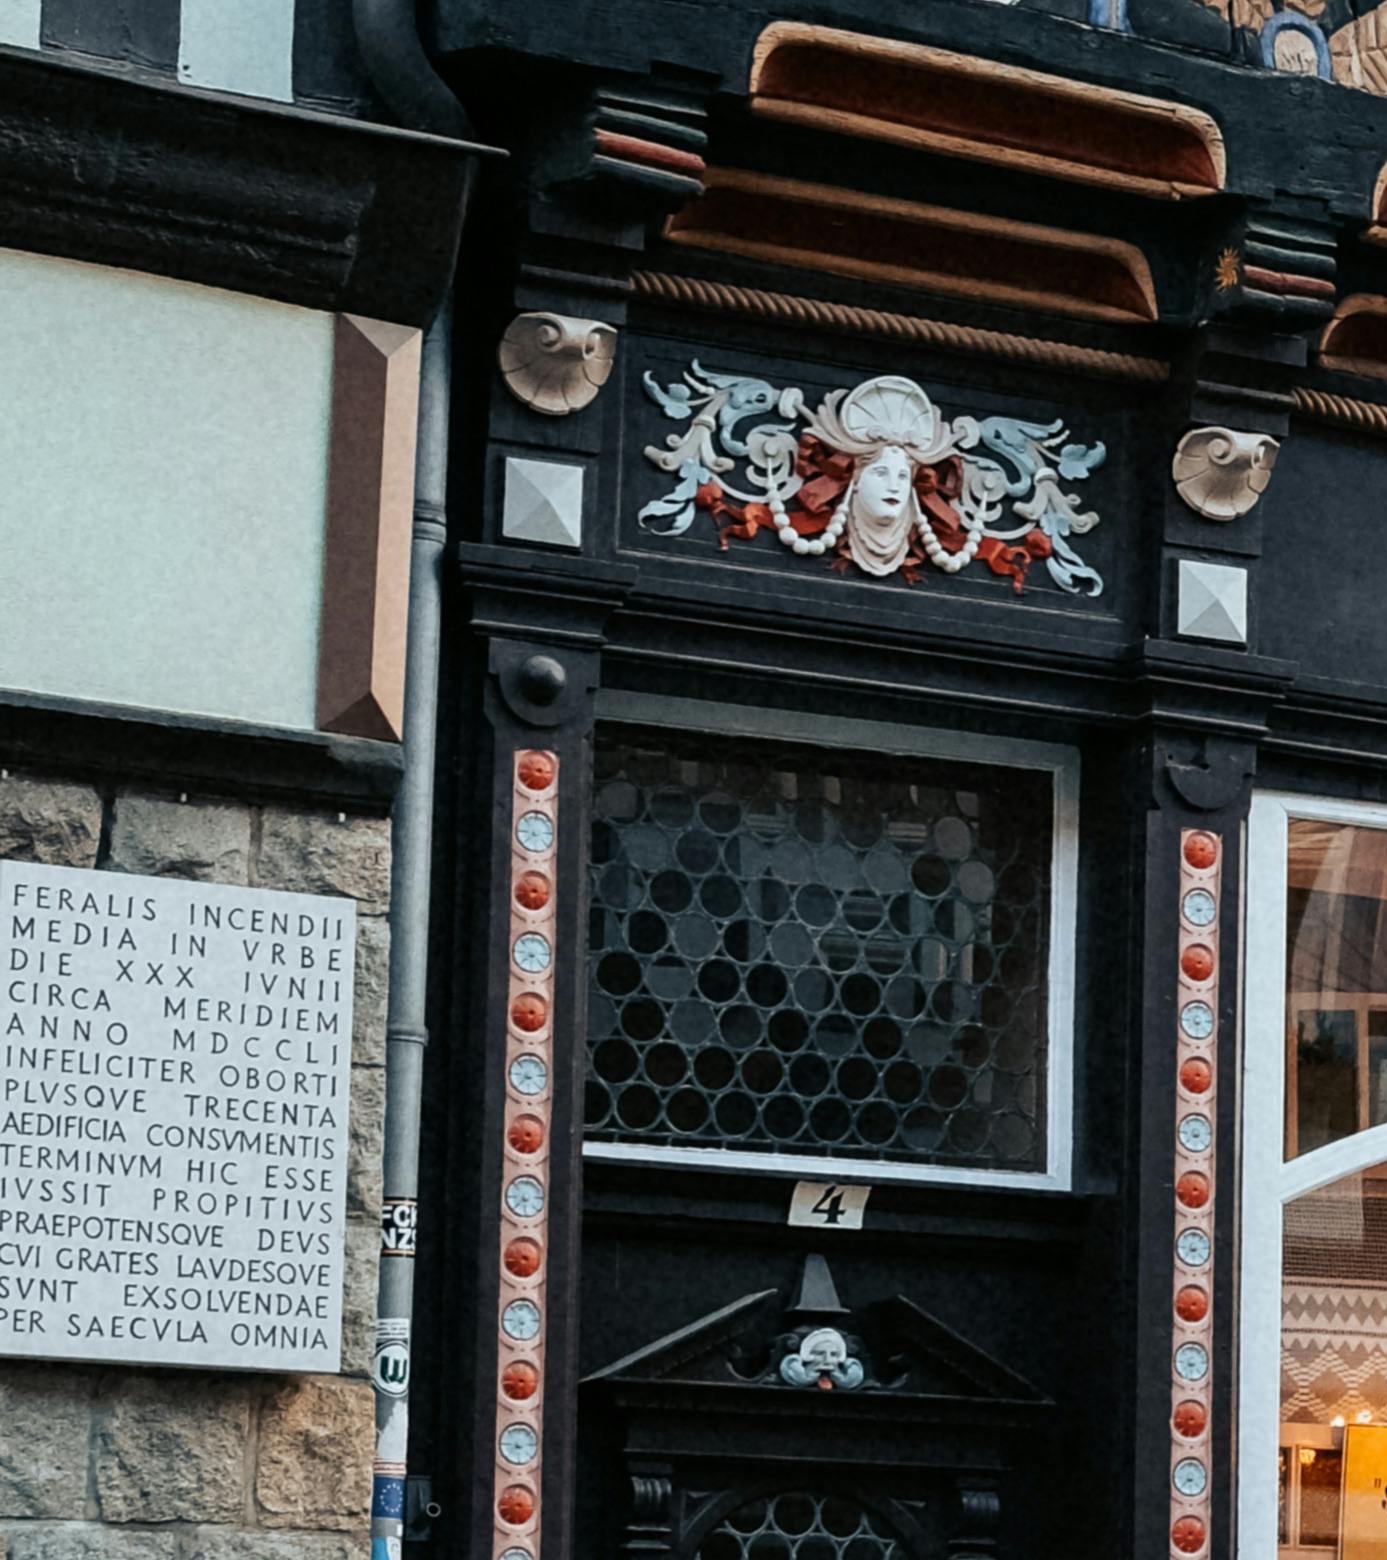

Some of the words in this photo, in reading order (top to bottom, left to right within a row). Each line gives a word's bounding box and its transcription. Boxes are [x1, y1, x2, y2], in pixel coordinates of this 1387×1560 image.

[14, 884, 156, 921] FERALIS
[190, 903, 342, 941] INCENDII
[12, 915, 137, 951] MEDIA
[171, 933, 206, 958] IN
[243, 939, 341, 971] VRBE
[9, 948, 72, 976] DIE
[115, 959, 194, 988] XXX
[244, 971, 339, 1002] IVNII
[8, 981, 111, 1012] CIRCA
[164, 996, 338, 1034] MERIDIEM
[6, 1012, 128, 1045] ANNO
[172, 1029, 337, 1066] MDCCLI
[6, 1045, 195, 1084] INFELICITER
[219, 1065, 336, 1097] OBORTI
[5, 1079, 147, 1112] PLVSQVE
[184, 1094, 337, 1128] TRECENTA
[3, 1111, 126, 1143] AEDIFICIA
[147, 1124, 335, 1160] CONSVMENTIS
[0, 1143, 162, 1178] TERMINVM
[187, 1159, 238, 1185] HIC
[265, 1165, 334, 1192] ESSE
[0, 1178, 112, 1207] IVSSIT
[153, 1188, 333, 1224] PROPITIVS
[811, 1185, 847, 1224] 4
[0, 1210, 224, 1247] PRAEPOTENSQVE
[258, 1228, 330, 1255] DEVS
[0, 1242, 41, 1268] CVI
[56, 1247, 159, 1276] GRATES
[177, 1254, 331, 1287] LAVDESQVE
[0, 1276, 78, 1303] SVNT
[124, 1284, 328, 1319] EXSOLVENDAE
[67, 1314, 208, 1343] SAECVLA
[231, 1323, 328, 1350] OMNIA
